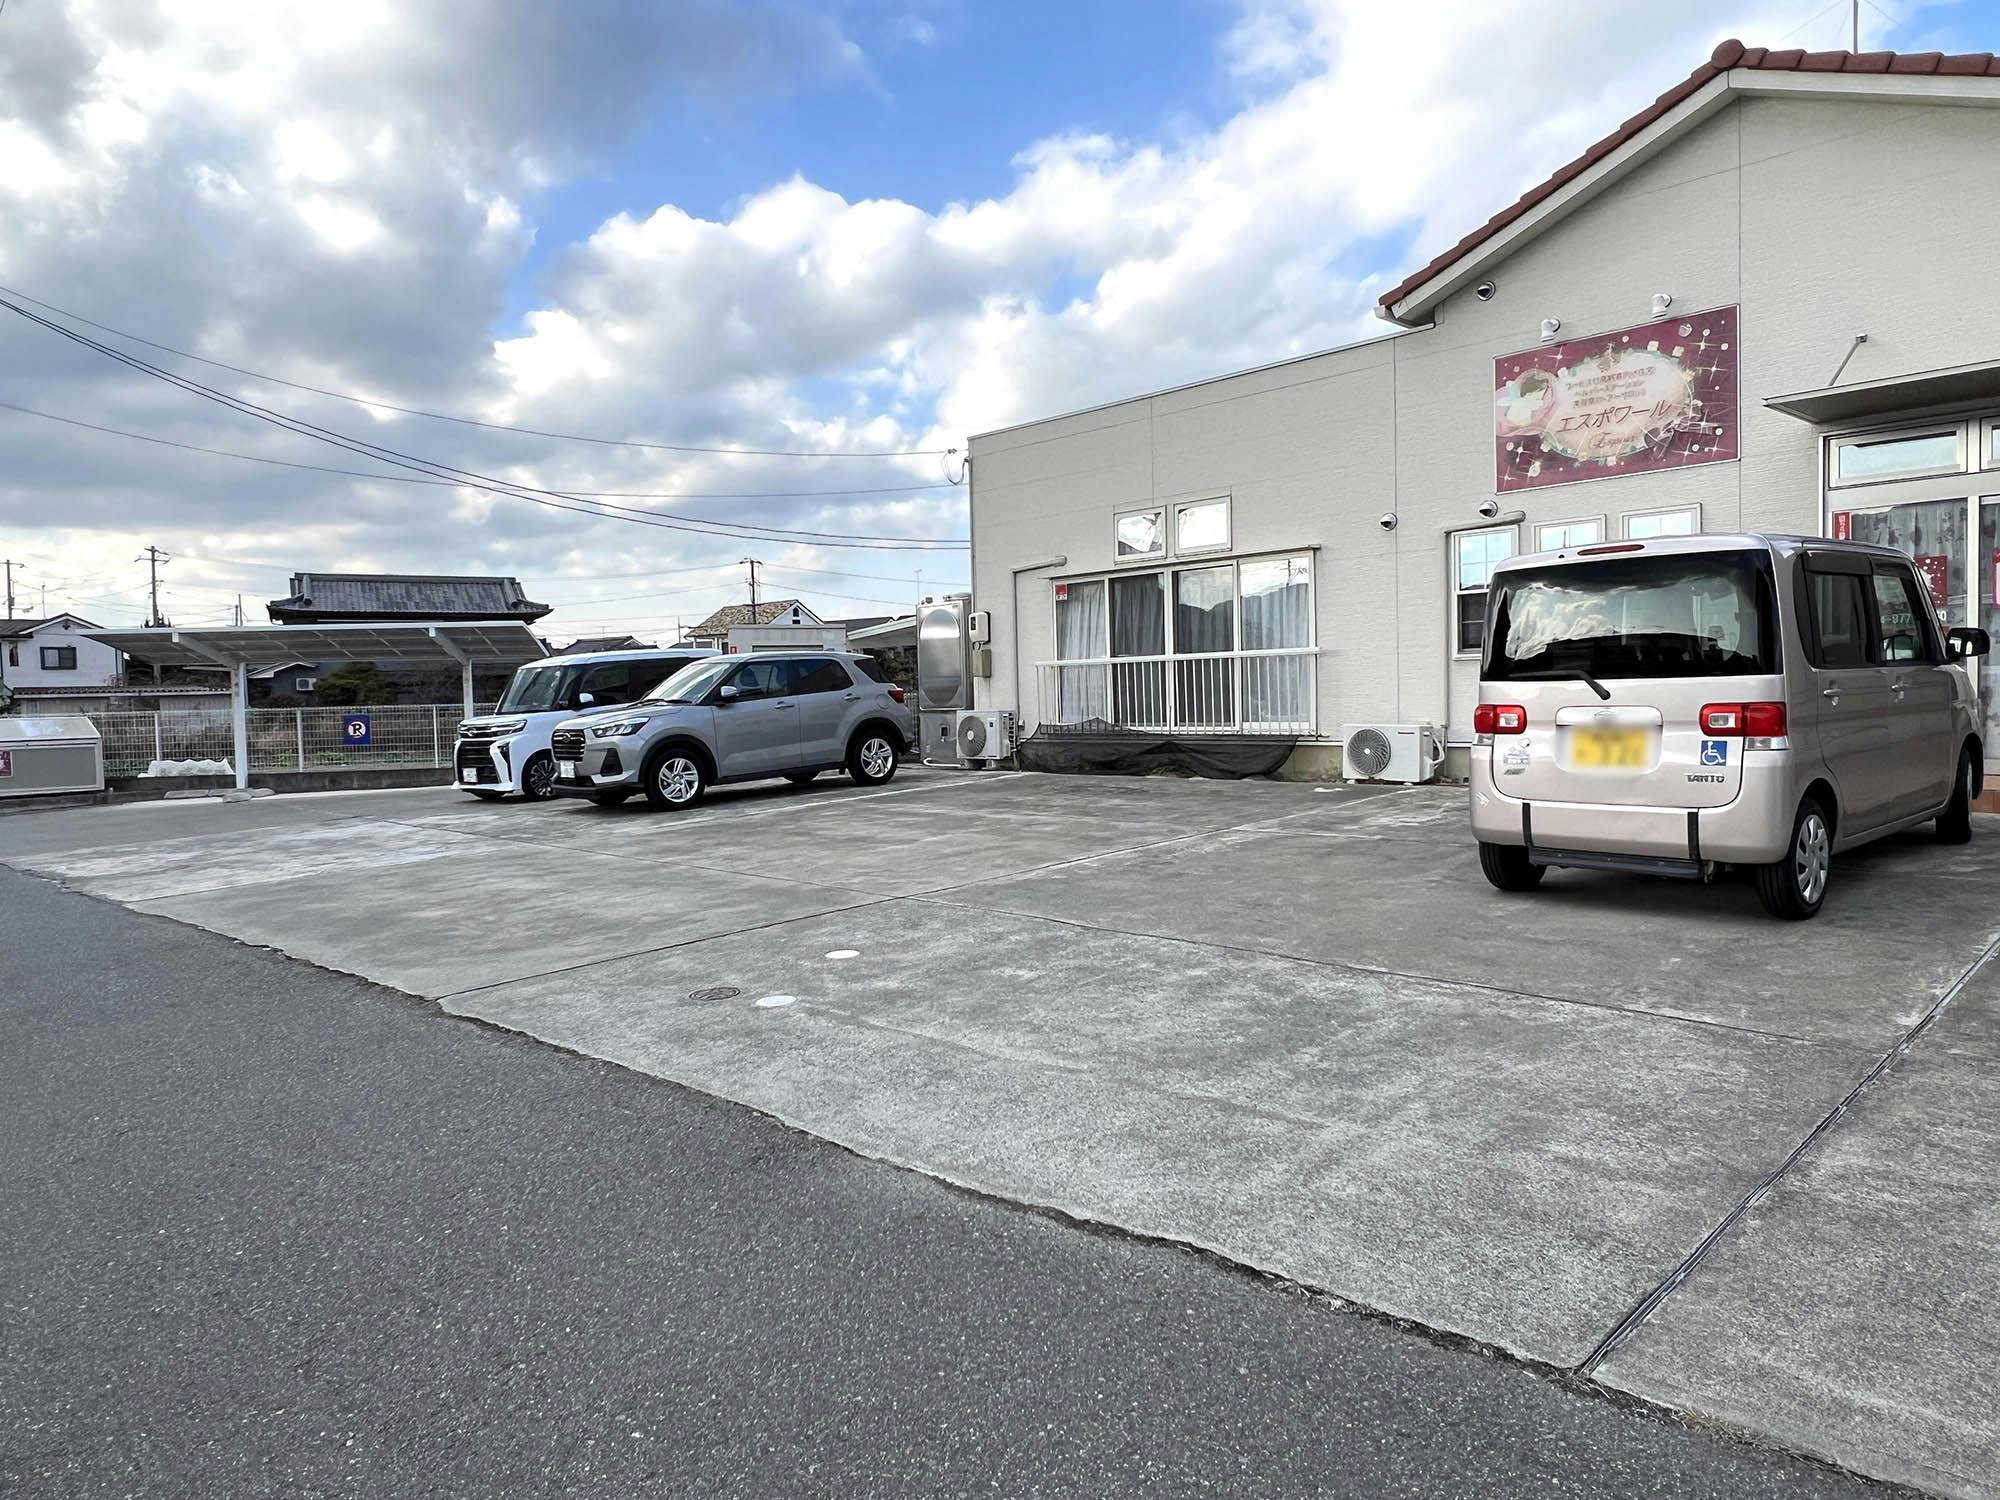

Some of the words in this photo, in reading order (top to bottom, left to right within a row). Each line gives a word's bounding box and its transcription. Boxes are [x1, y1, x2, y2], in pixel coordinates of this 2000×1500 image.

[1557, 400, 1671, 432] エスポワール
